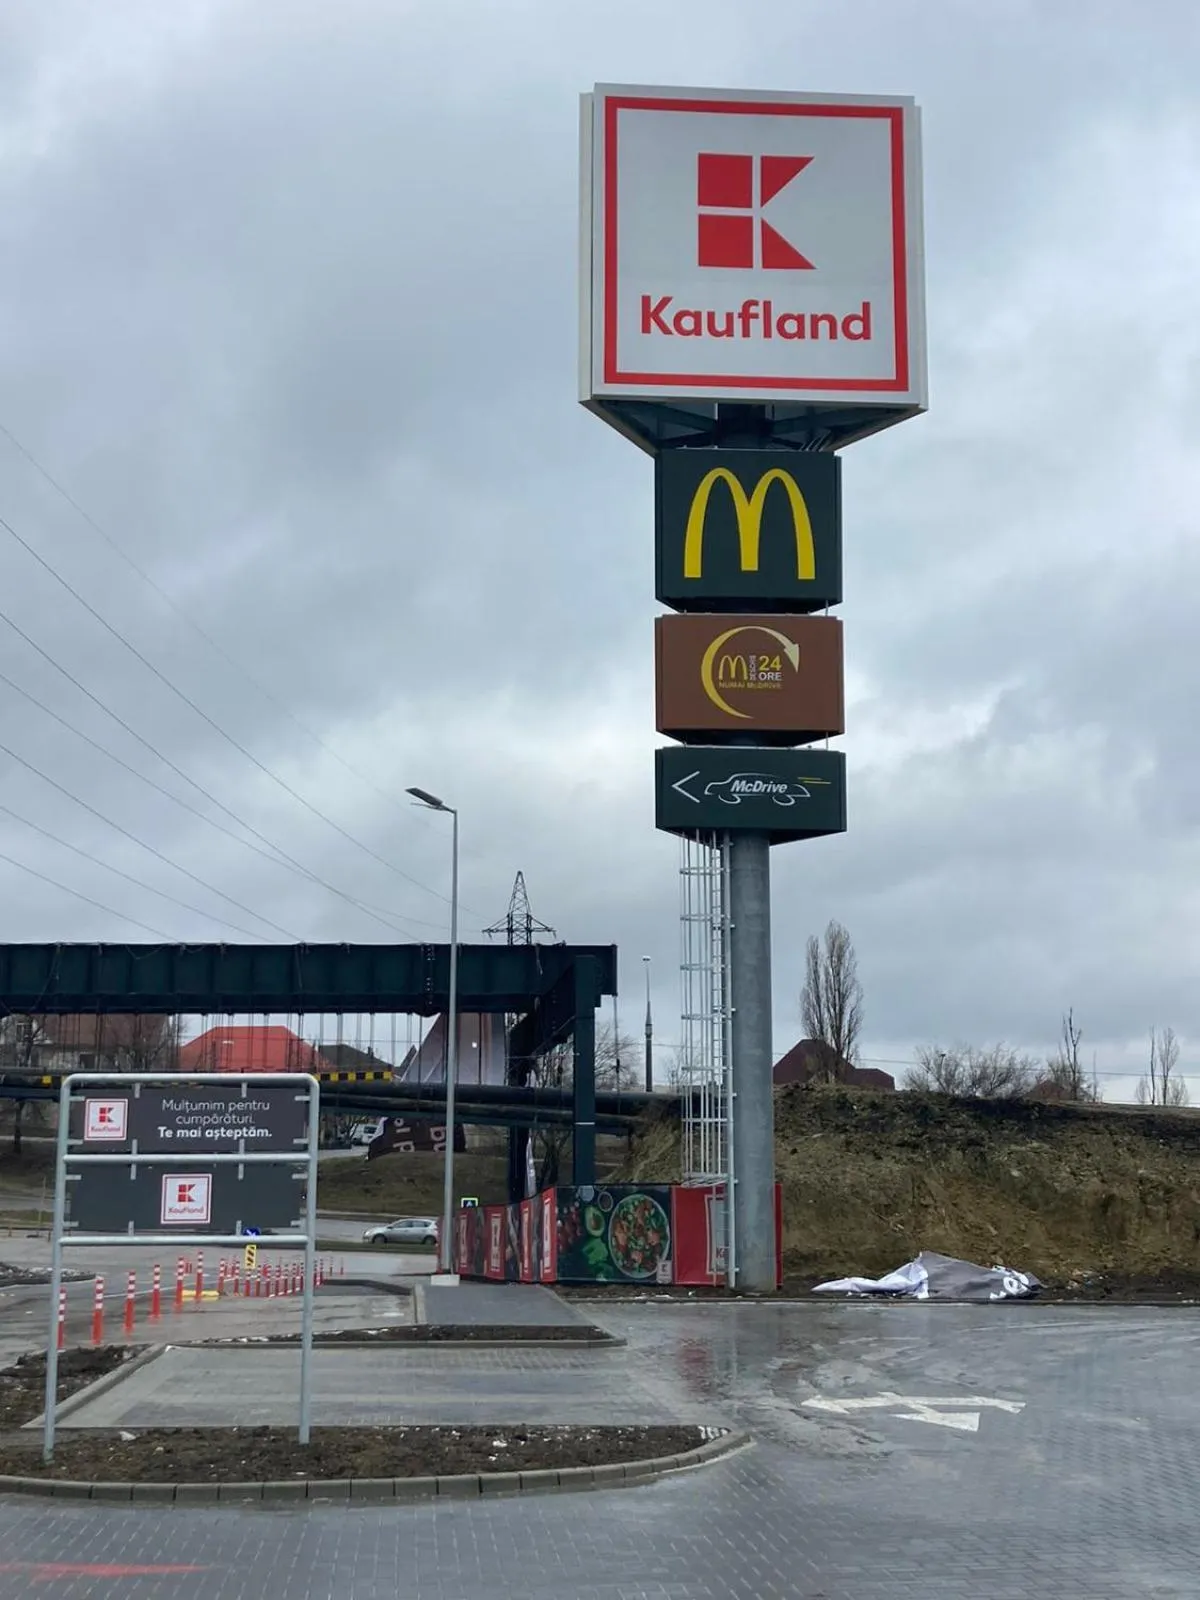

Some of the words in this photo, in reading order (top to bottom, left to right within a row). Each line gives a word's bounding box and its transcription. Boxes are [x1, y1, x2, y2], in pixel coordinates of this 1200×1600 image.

[640, 295, 872, 341] Kaufland
[759, 655, 782, 671] 24
[758, 671, 783, 681] ORE
[730, 780, 788, 794] McDrive
[228, 1100, 271, 1113] pentru
[157, 1126, 173, 1138] Te
[176, 1126, 202, 1138] mai
[168, 1206, 204, 1214] Kaufland
